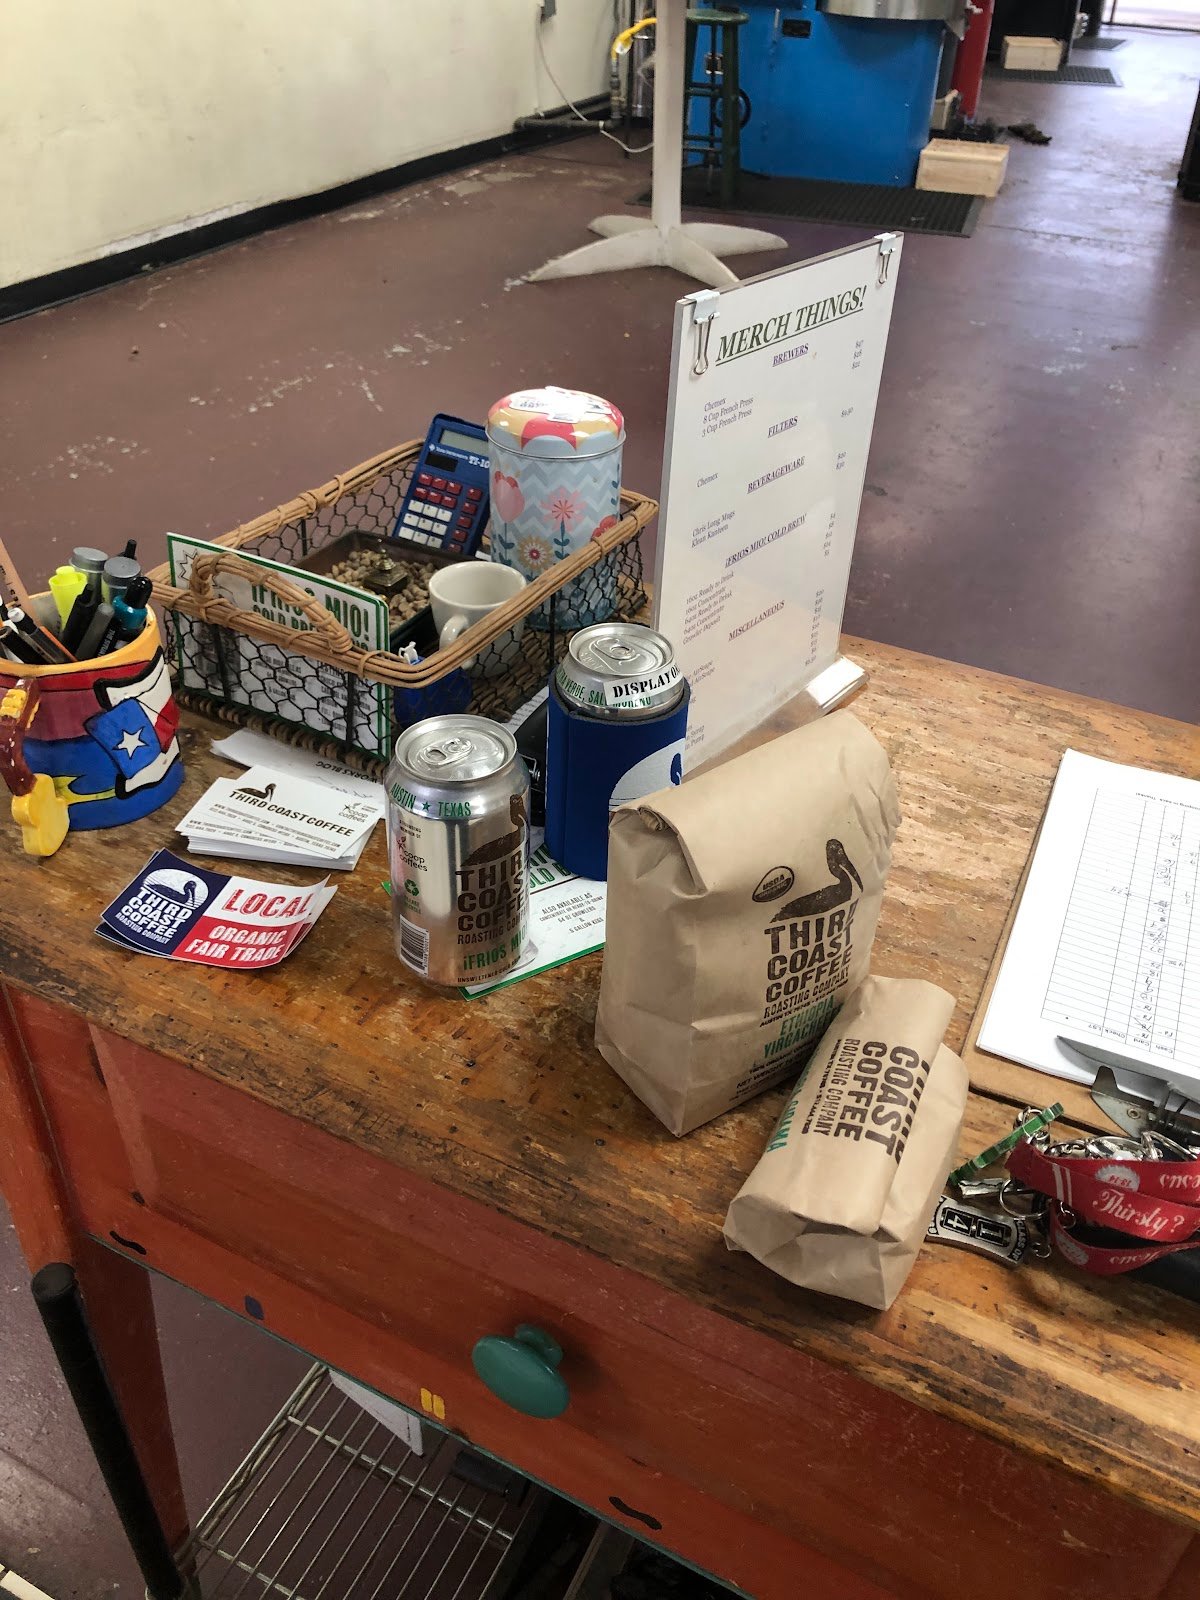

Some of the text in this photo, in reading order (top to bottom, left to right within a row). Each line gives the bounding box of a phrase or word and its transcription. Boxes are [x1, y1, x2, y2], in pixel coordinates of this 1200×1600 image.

[715, 285, 867, 363] MERCH THINGS!
[772, 343, 809, 367] BREWERS
[708, 412, 720, 422] Cup
[768, 416, 798, 438] FILTERS
[468, 455, 490, 469] TI-10
[747, 456, 806, 494] BEVERAGEWARE
[697, 473, 719, 488] Chemex
[767, 526, 788, 544] COLD
[787, 513, 808, 536] BREW
[728, 600, 785, 642] MISCELLANEOUS
[612, 671, 670, 698] DISPLAY
[315, 761, 341, 775] BLOG
[229, 790, 267, 809] THIRD
[267, 804, 310, 821] COAST
[307, 817, 355, 838] COFFEE
[390, 782, 417, 810] AUSTIN
[437, 801, 472, 818] TEXAS
[399, 853, 428, 872] coffees
[403, 850, 425, 865] coop
[455, 850, 522, 892] THIR
[457, 870, 524, 913] COAS
[762, 874, 785, 891] USDA
[128, 897, 185, 929] COAST
[134, 886, 193, 921] THIRD
[222, 889, 314, 918] LOCAL
[457, 889, 525, 932] COFFE
[541, 905, 557, 915] ALSO
[556, 895, 584, 909] AVAILABLE
[115, 912, 172, 945] ROASTING COMPANY
[120, 905, 178, 939] COFFEE
[208, 925, 286, 946] ORGANIC
[457, 925, 504, 945] ROASTING
[573, 921, 592, 931] GALLON
[185, 938, 286, 962] FAIR TRADE
[767, 918, 854, 981] COAST
[765, 944, 853, 1003] COFFEE
[764, 989, 810, 1019] ROASTING
[780, 994, 835, 1036] ETHIOPIA
[813, 1038, 861, 1136] ROASTING COMPANY
[834, 1041, 888, 1142] COFFEE
[865, 1045, 920, 1156] COAST
